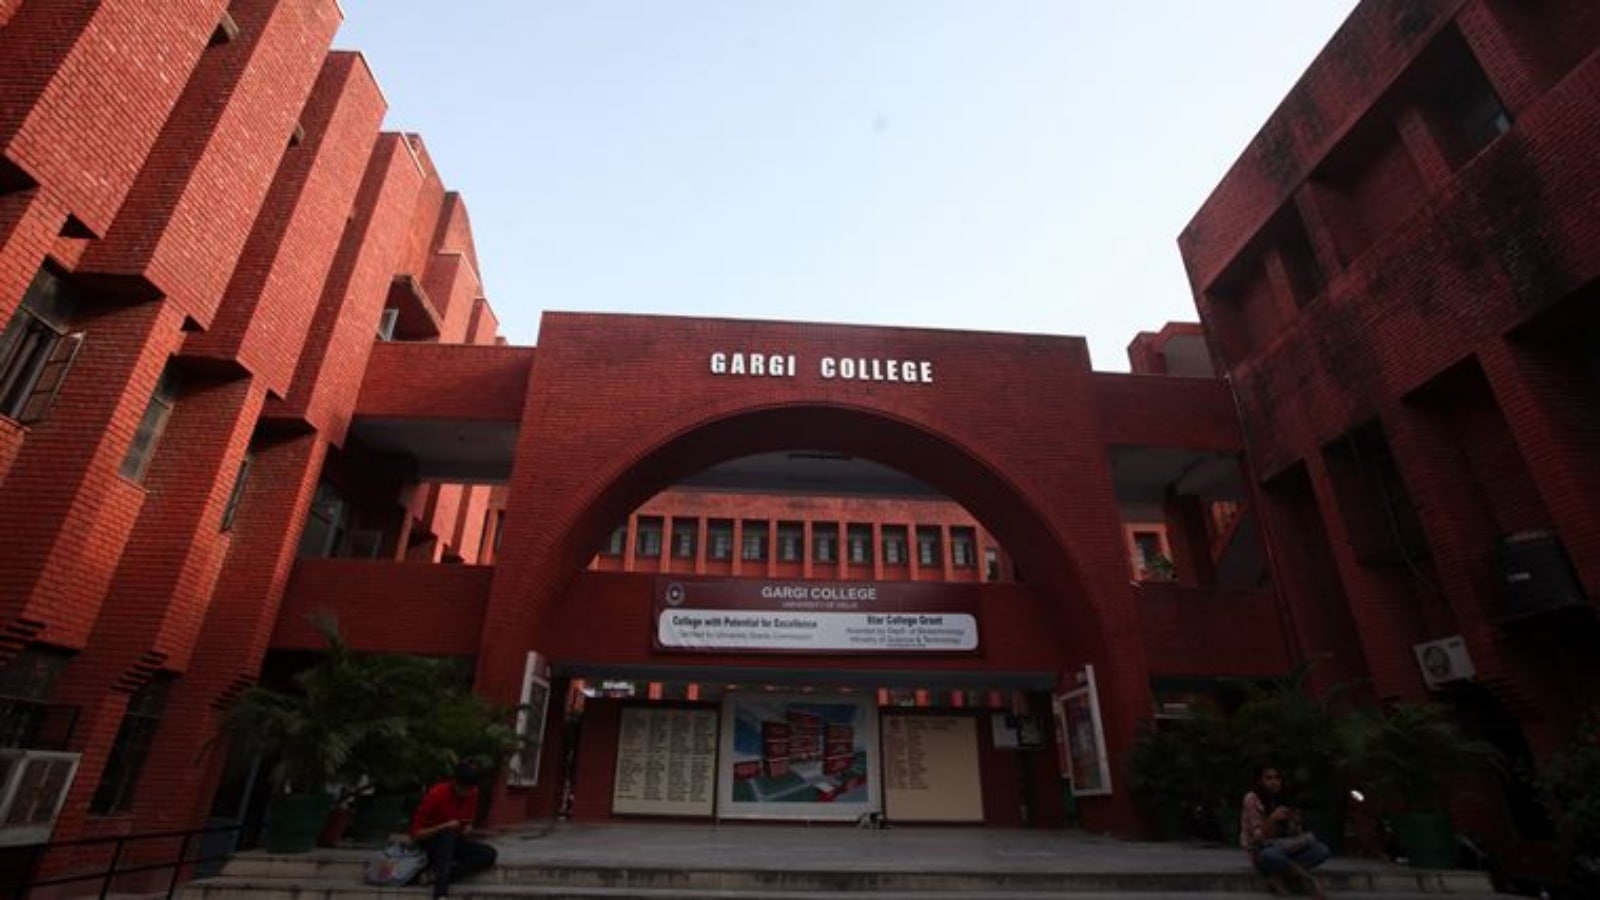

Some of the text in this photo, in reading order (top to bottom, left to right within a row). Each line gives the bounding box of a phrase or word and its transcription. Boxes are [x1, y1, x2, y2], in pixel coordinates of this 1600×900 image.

[710, 352, 933, 383] GARGI COLLEGE
[761, 586, 877, 601] GARGI COLLEGE
[672, 615, 818, 630] College with Potential for Excellence
[886, 615, 918, 628] College
